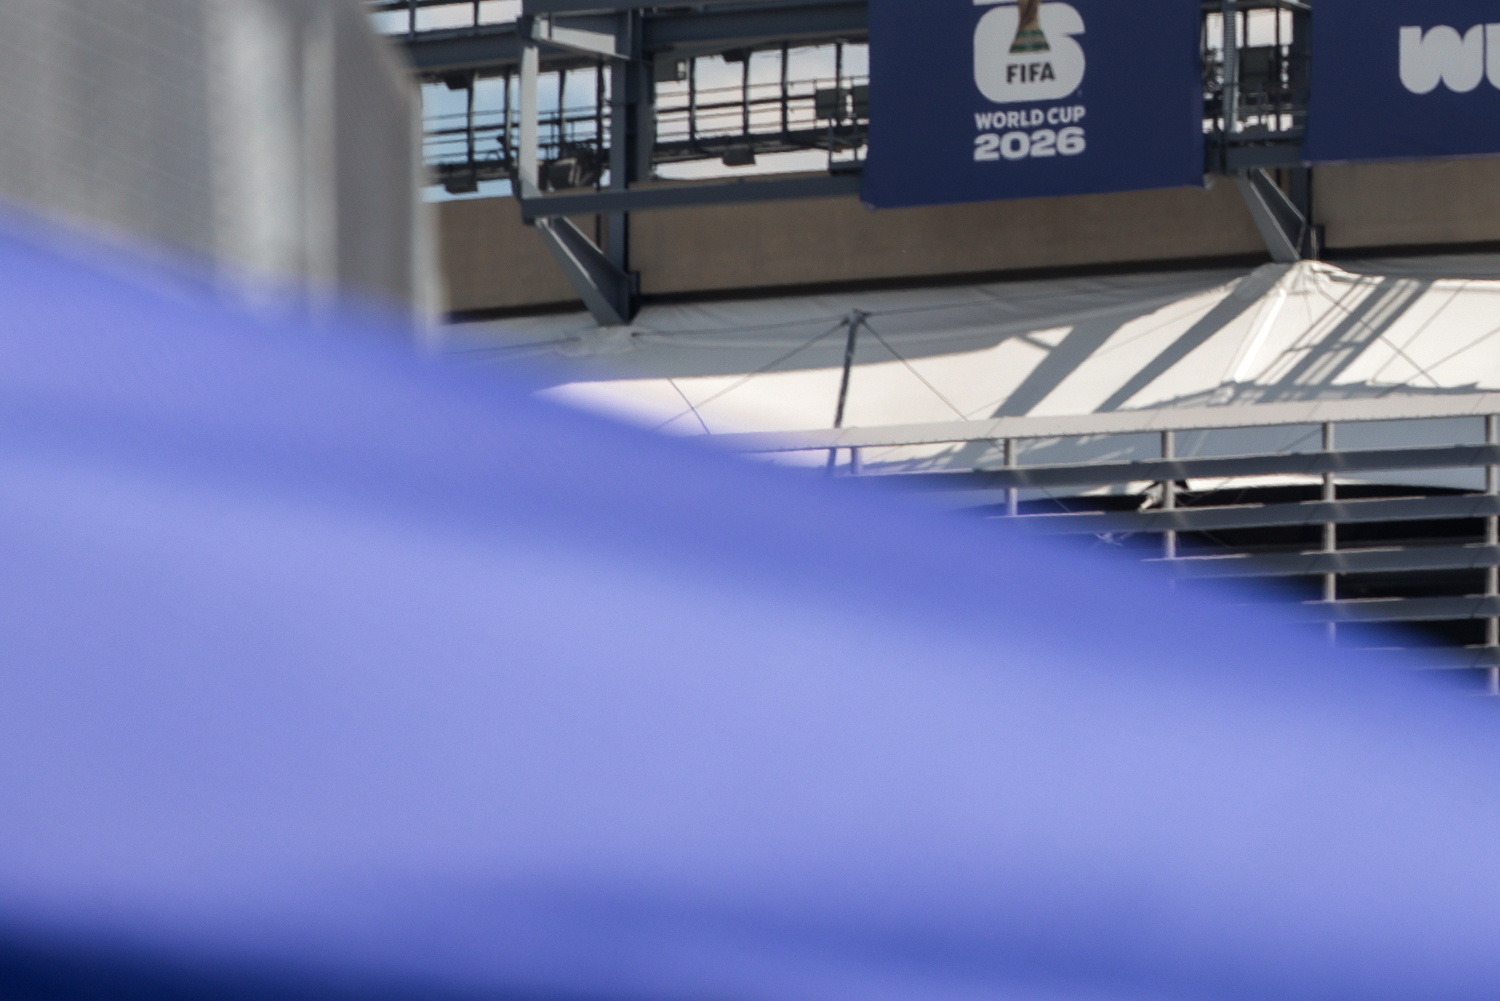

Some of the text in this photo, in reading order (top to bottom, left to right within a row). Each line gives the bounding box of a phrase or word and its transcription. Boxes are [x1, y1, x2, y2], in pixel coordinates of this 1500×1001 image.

[1006, 62, 1055, 83] FIFA
[974, 105, 1086, 131] WORLD CUP
[973, 126, 1087, 161] 2026
